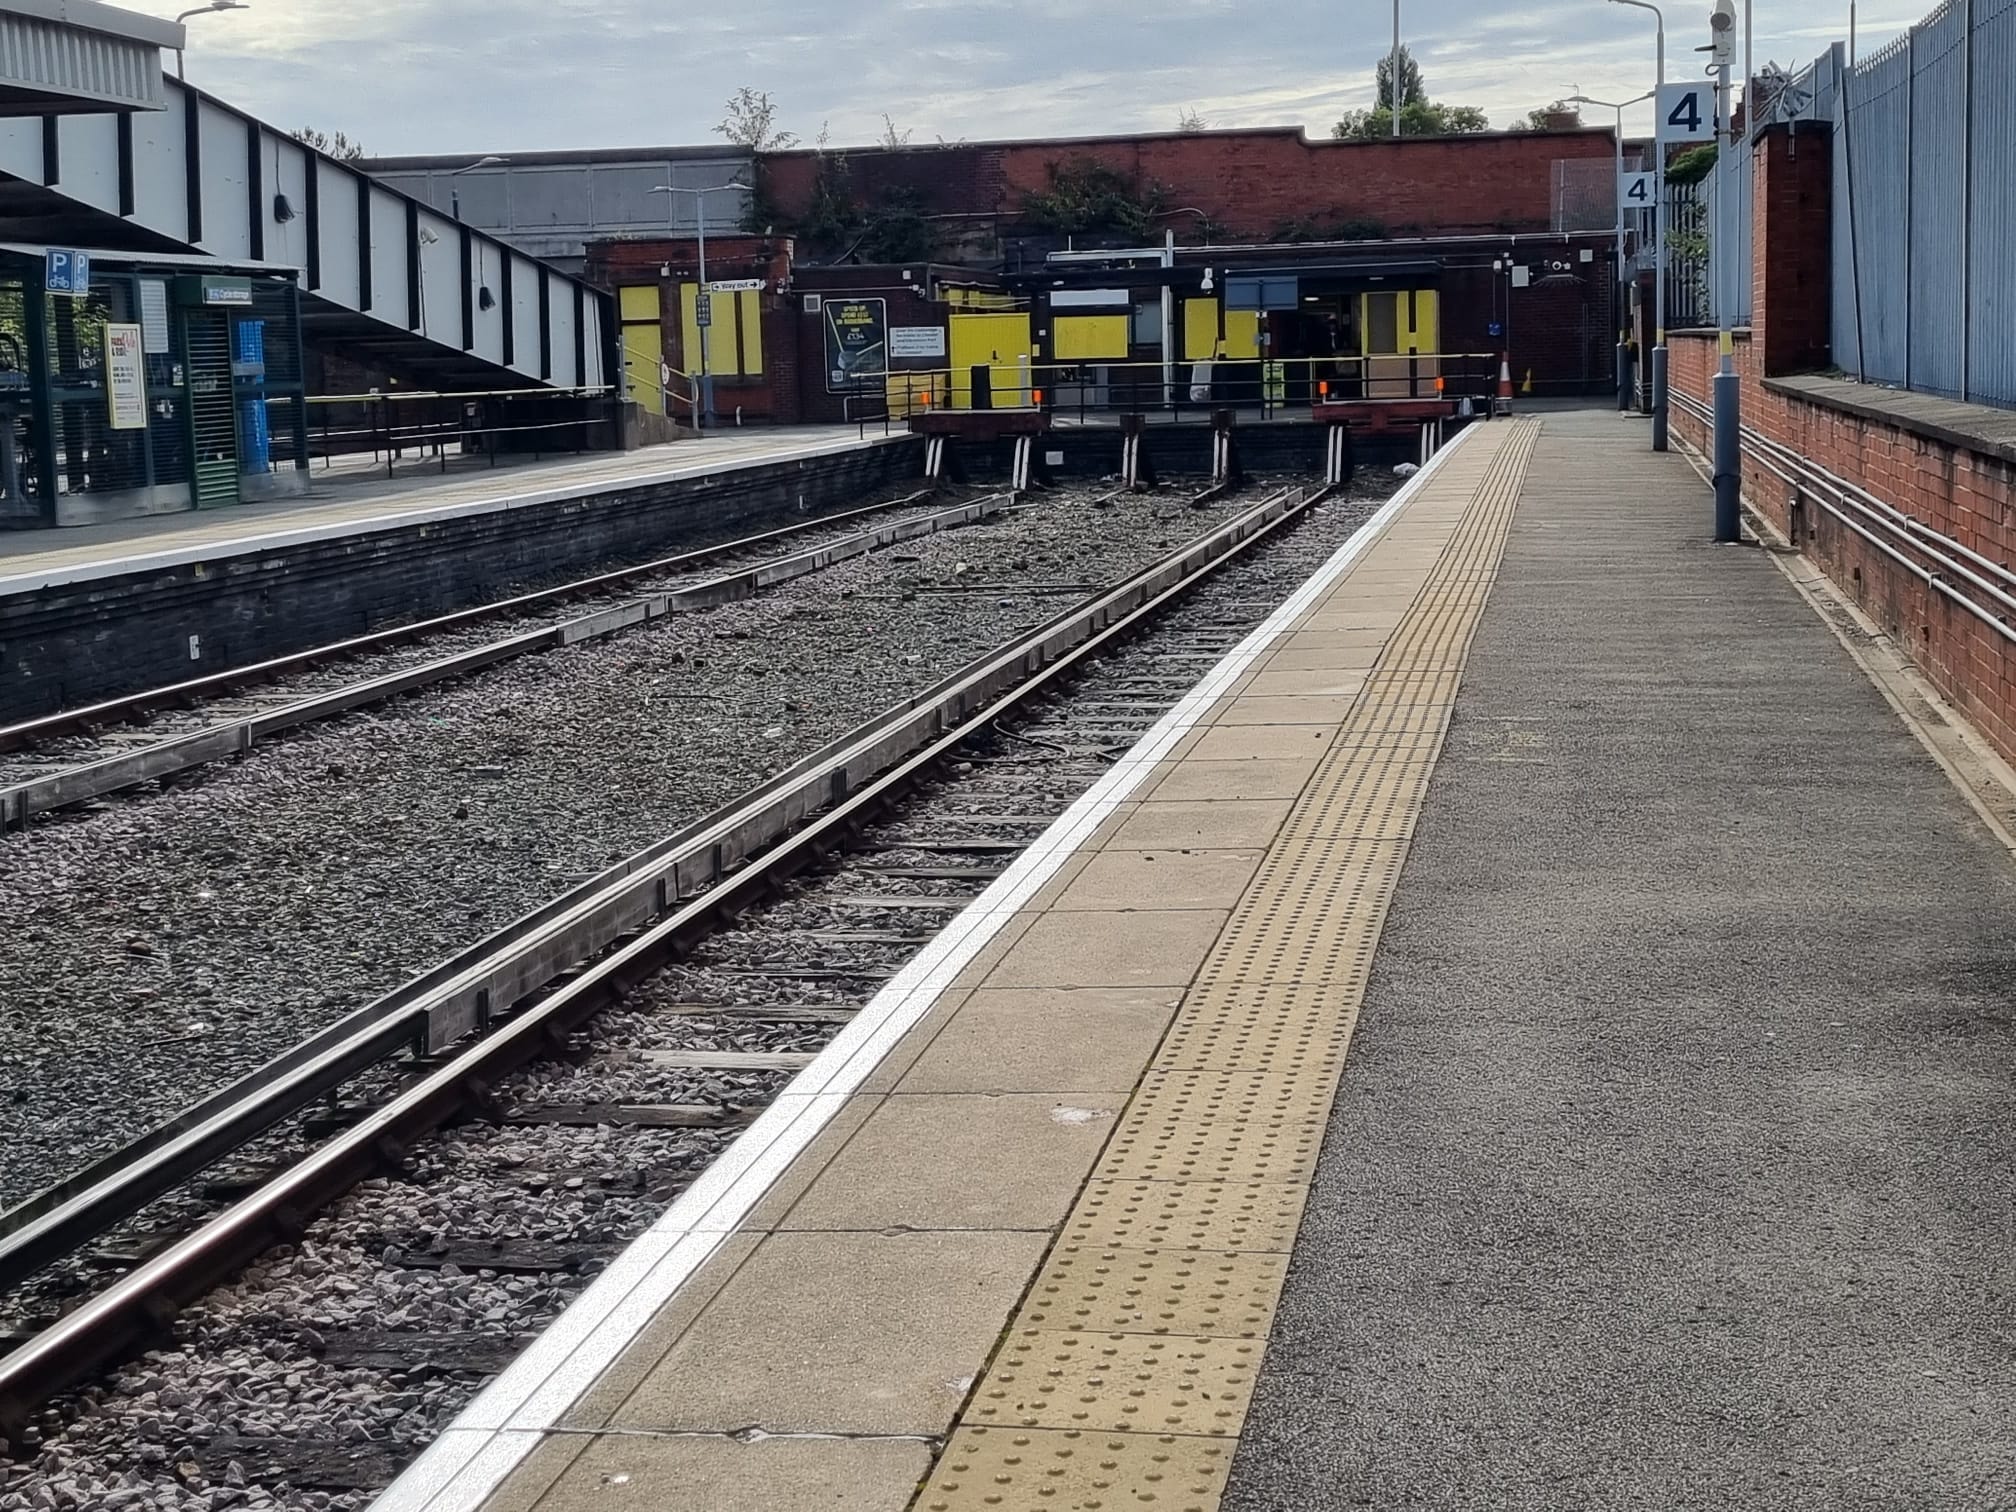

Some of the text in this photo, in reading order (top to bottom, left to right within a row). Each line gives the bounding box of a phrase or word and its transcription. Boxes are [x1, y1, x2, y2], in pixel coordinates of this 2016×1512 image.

[1668, 92, 1702, 132] 4
[1627, 178, 1648, 201] 4
[53, 253, 68, 273] P
